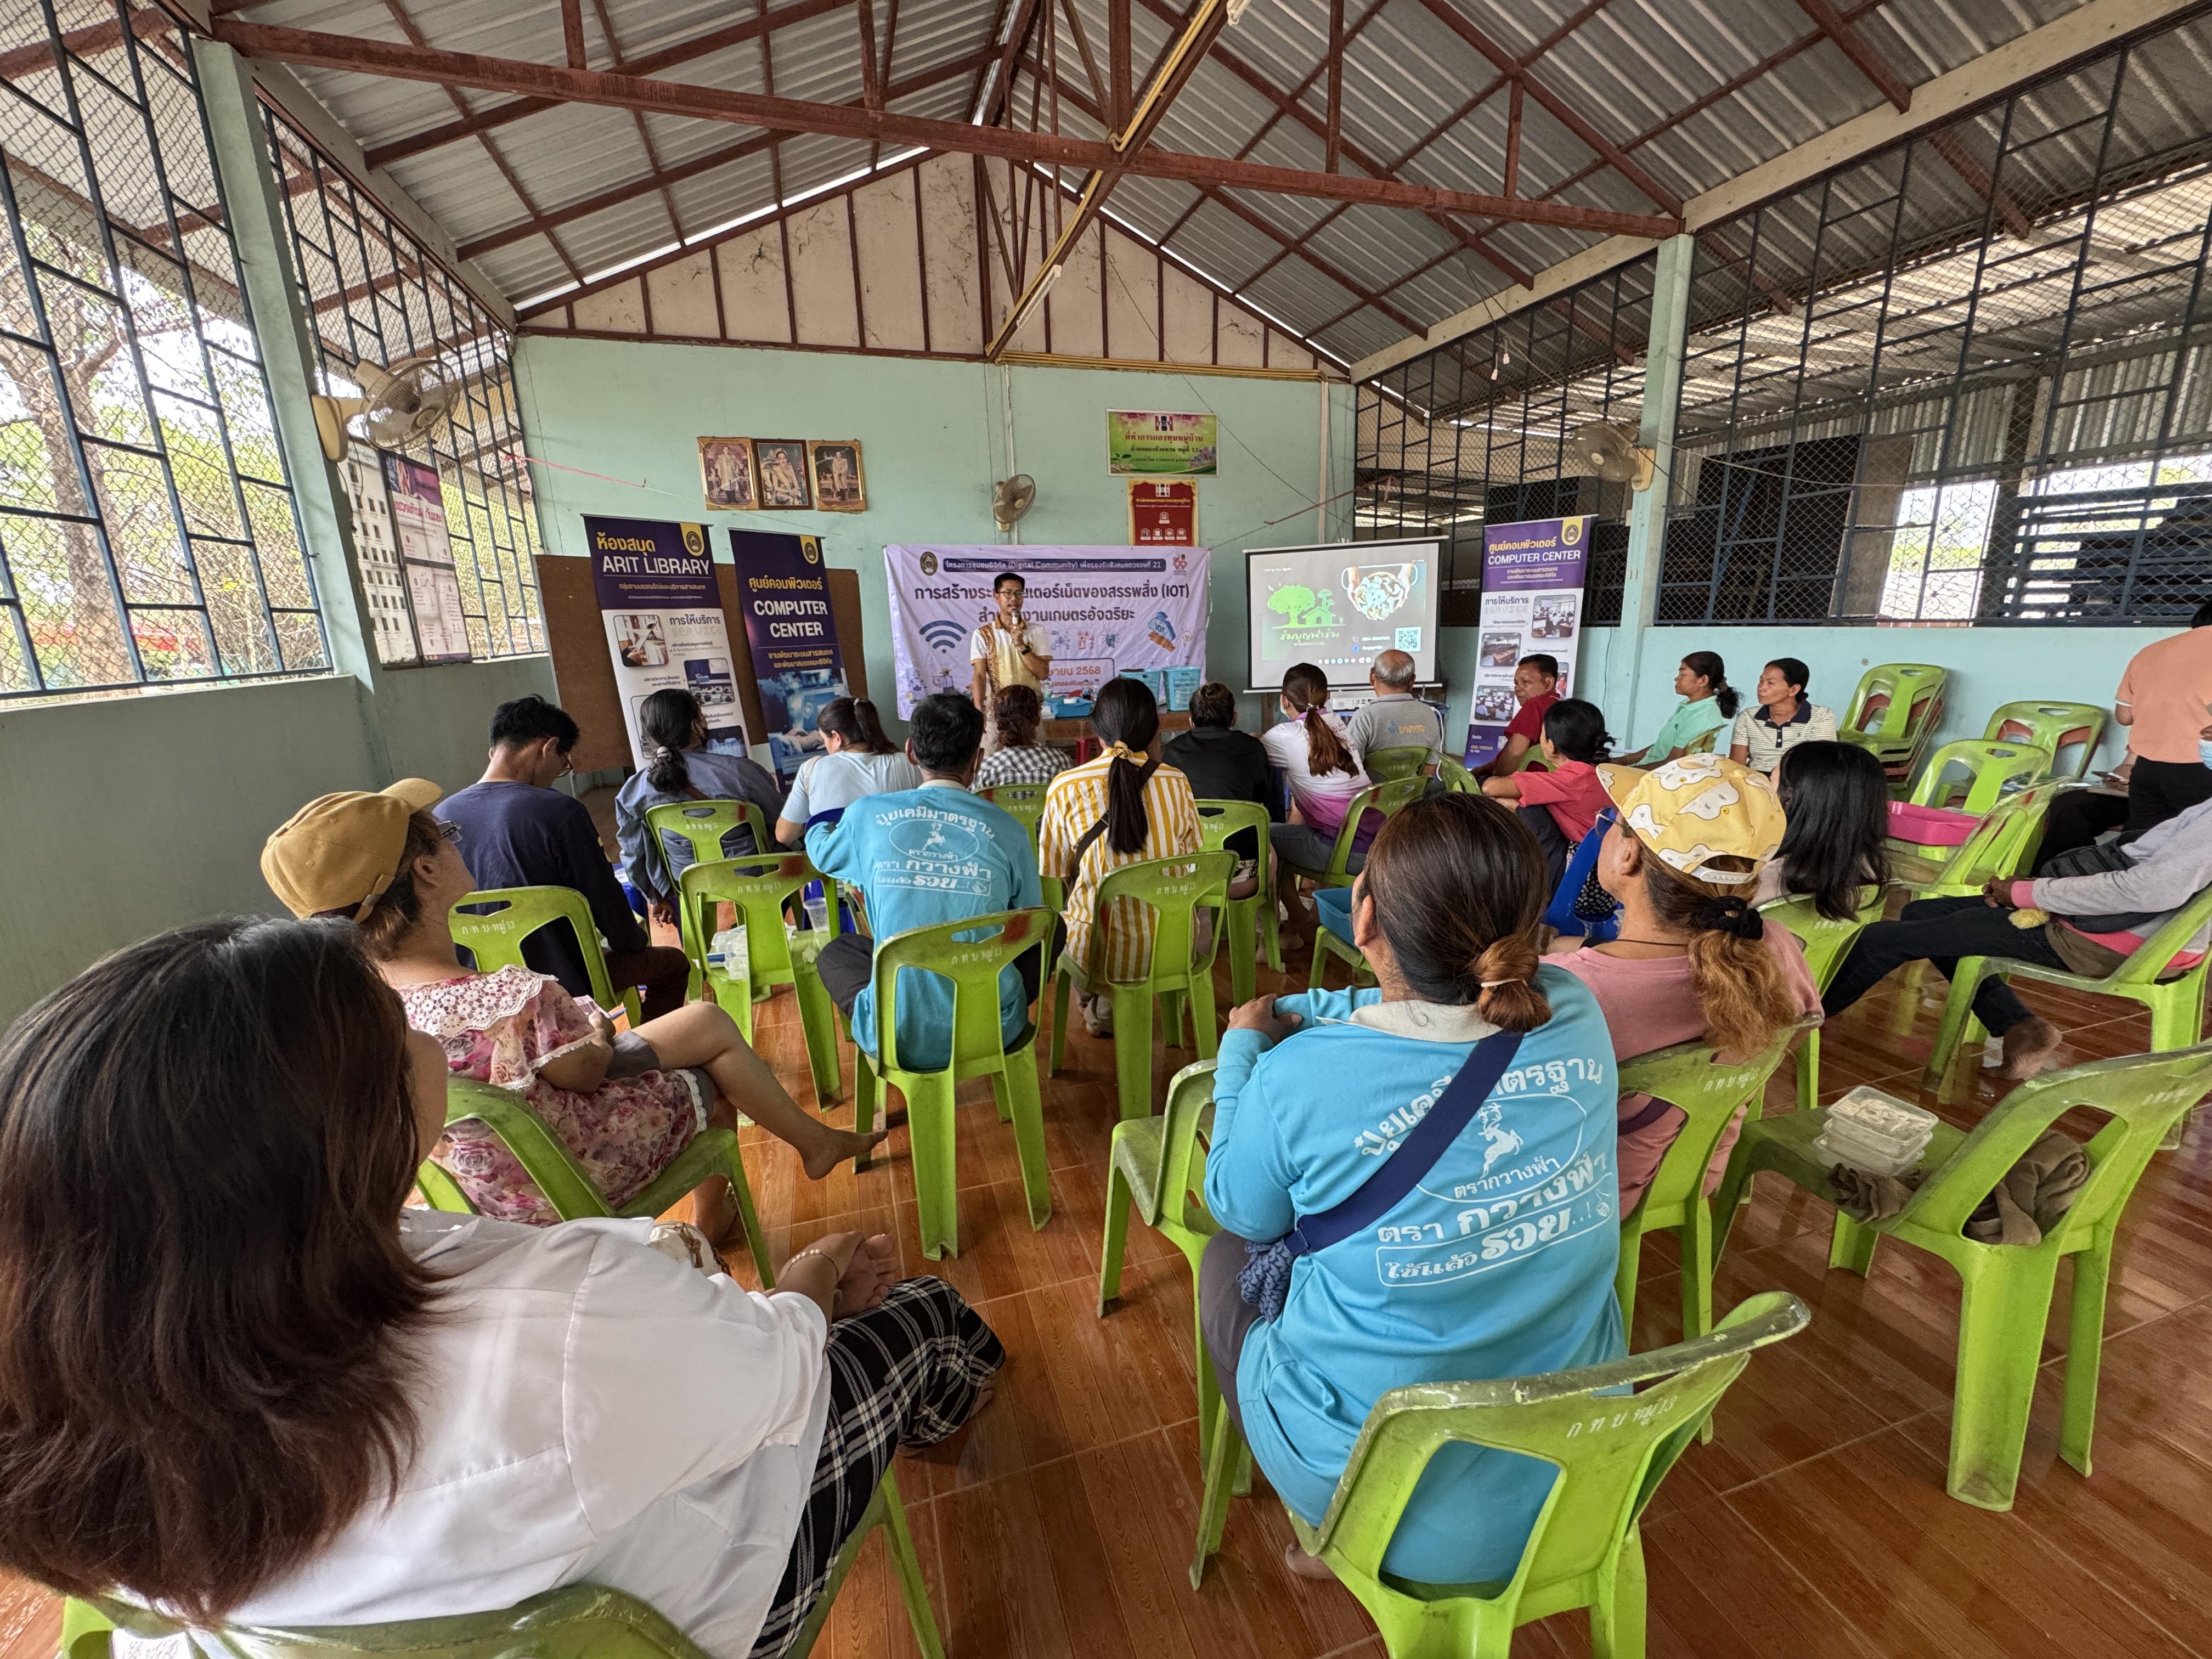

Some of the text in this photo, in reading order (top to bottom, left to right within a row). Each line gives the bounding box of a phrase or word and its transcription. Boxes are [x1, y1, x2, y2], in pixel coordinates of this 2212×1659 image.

[1125, 430, 1203, 444] ที่ทำการกองทุนหมู่บ้าน
[596, 532, 656, 556] ห้องสมุด
[1488, 537, 1557, 554] ศูนย์คอมพิวเตอร์
[603, 556, 709, 575] ARIT LIBRARY
[1008, 561, 1034, 571] (Digital
[1035, 561, 1079, 570] Community)
[1488, 550, 1581, 566] COMPUTER CENTER
[748, 574, 823, 592] ศูนย์คอมพิวเตอร์
[1161, 583, 1189, 599] (IOT)
[753, 600, 828, 616] COMPUTER
[1485, 595, 1530, 606] การให้บริการ
[669, 614, 721, 625] การให้บริการ
[770, 622, 824, 638] CENTER
[1155, 624, 1165, 633] IOT
[1076, 666, 1101, 675] 2568
[908, 849, 959, 861] ตรากวางฟ้า
[906, 859, 991, 879] กวางฟ้า
[1454, 1155, 1561, 1199] ตรากวางฟ้า
[1378, 1152, 1607, 1243] ตรา กวางฟ้า
[1385, 1251, 1478, 1279] ใช้แล้ว
